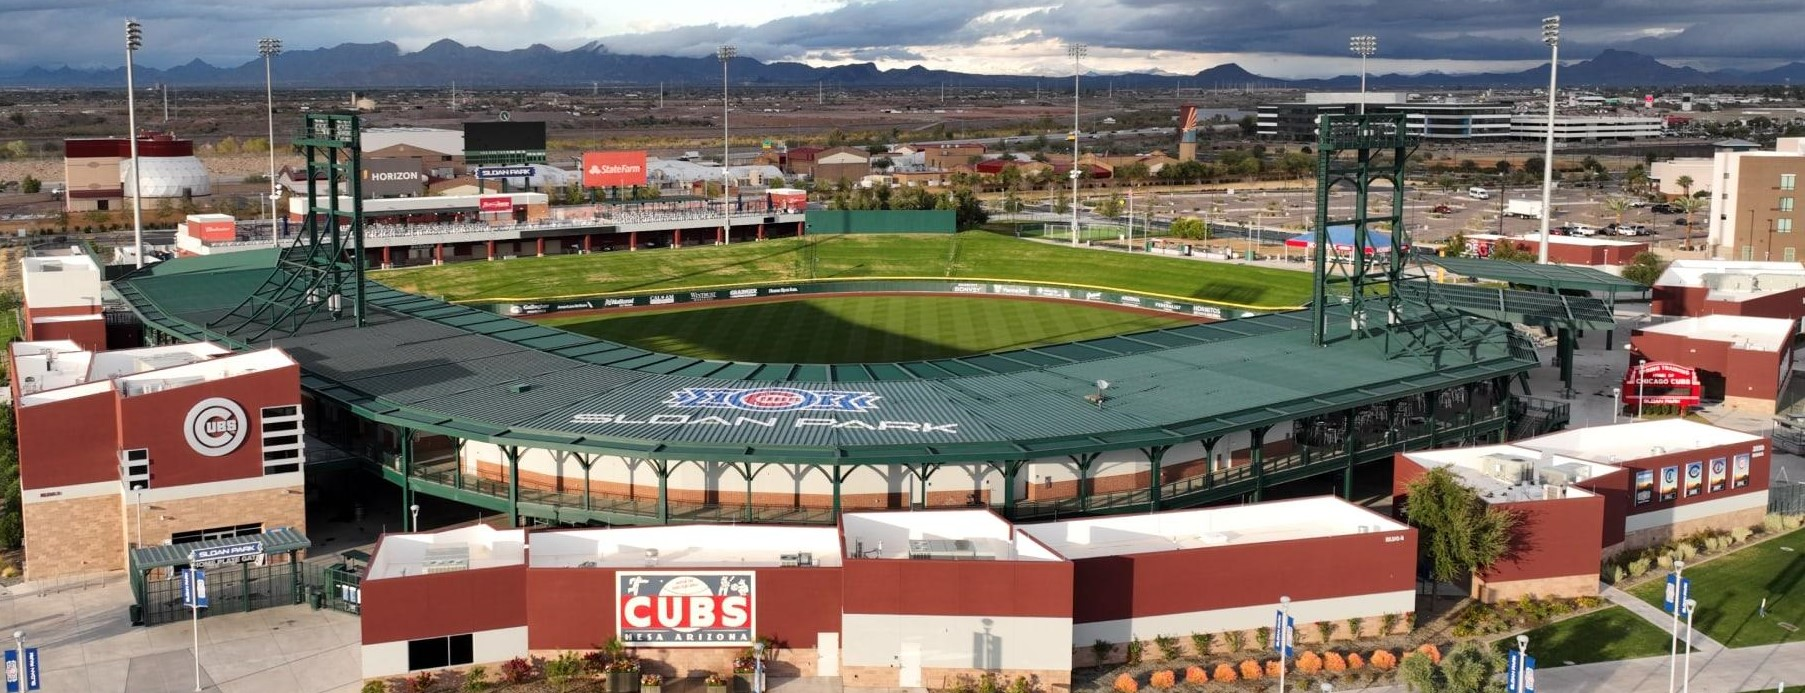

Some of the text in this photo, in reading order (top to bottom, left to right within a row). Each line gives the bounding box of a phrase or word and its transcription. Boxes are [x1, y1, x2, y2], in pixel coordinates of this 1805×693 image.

[371, 171, 418, 181] HORIZON
[569, 413, 959, 434] SLOAN PARK
[199, 545, 256, 557] SLOAN PARK
[624, 596, 748, 628] CUBS
[624, 633, 748, 641] MESA ARIZONA
